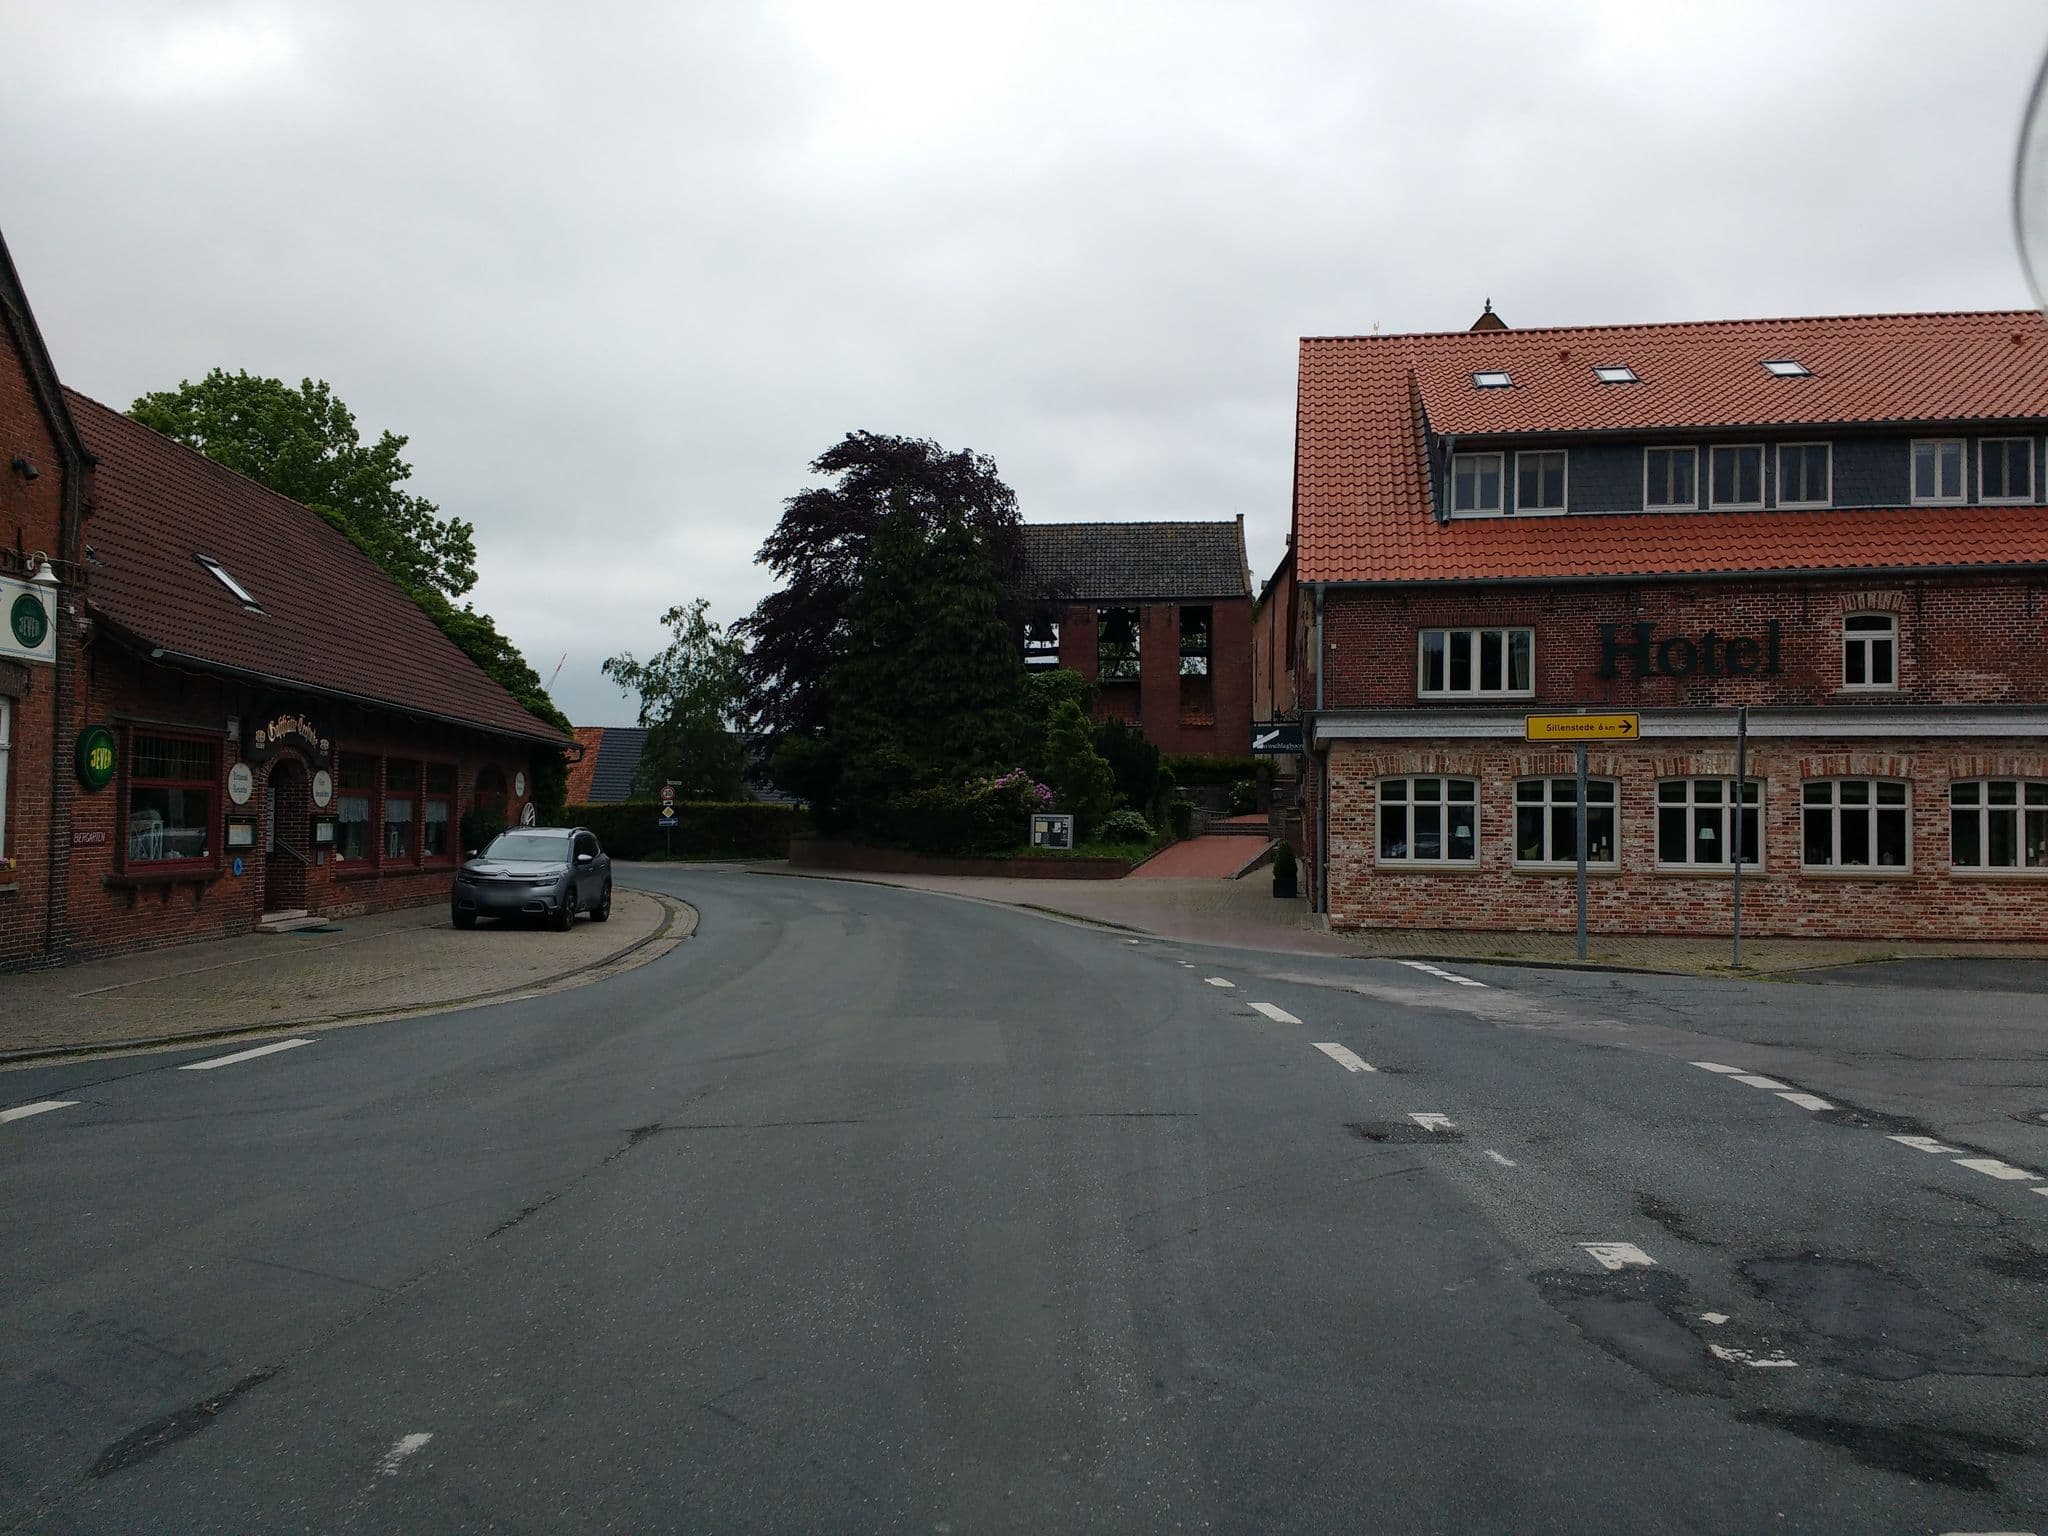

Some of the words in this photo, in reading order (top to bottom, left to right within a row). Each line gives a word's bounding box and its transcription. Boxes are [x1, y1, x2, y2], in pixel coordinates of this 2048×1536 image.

[1596, 619, 1785, 678] Hotel
[1546, 723, 1595, 732] Sillenstede
[1598, 723, 1604, 731] 6
[90, 747, 112, 770] JEVER
